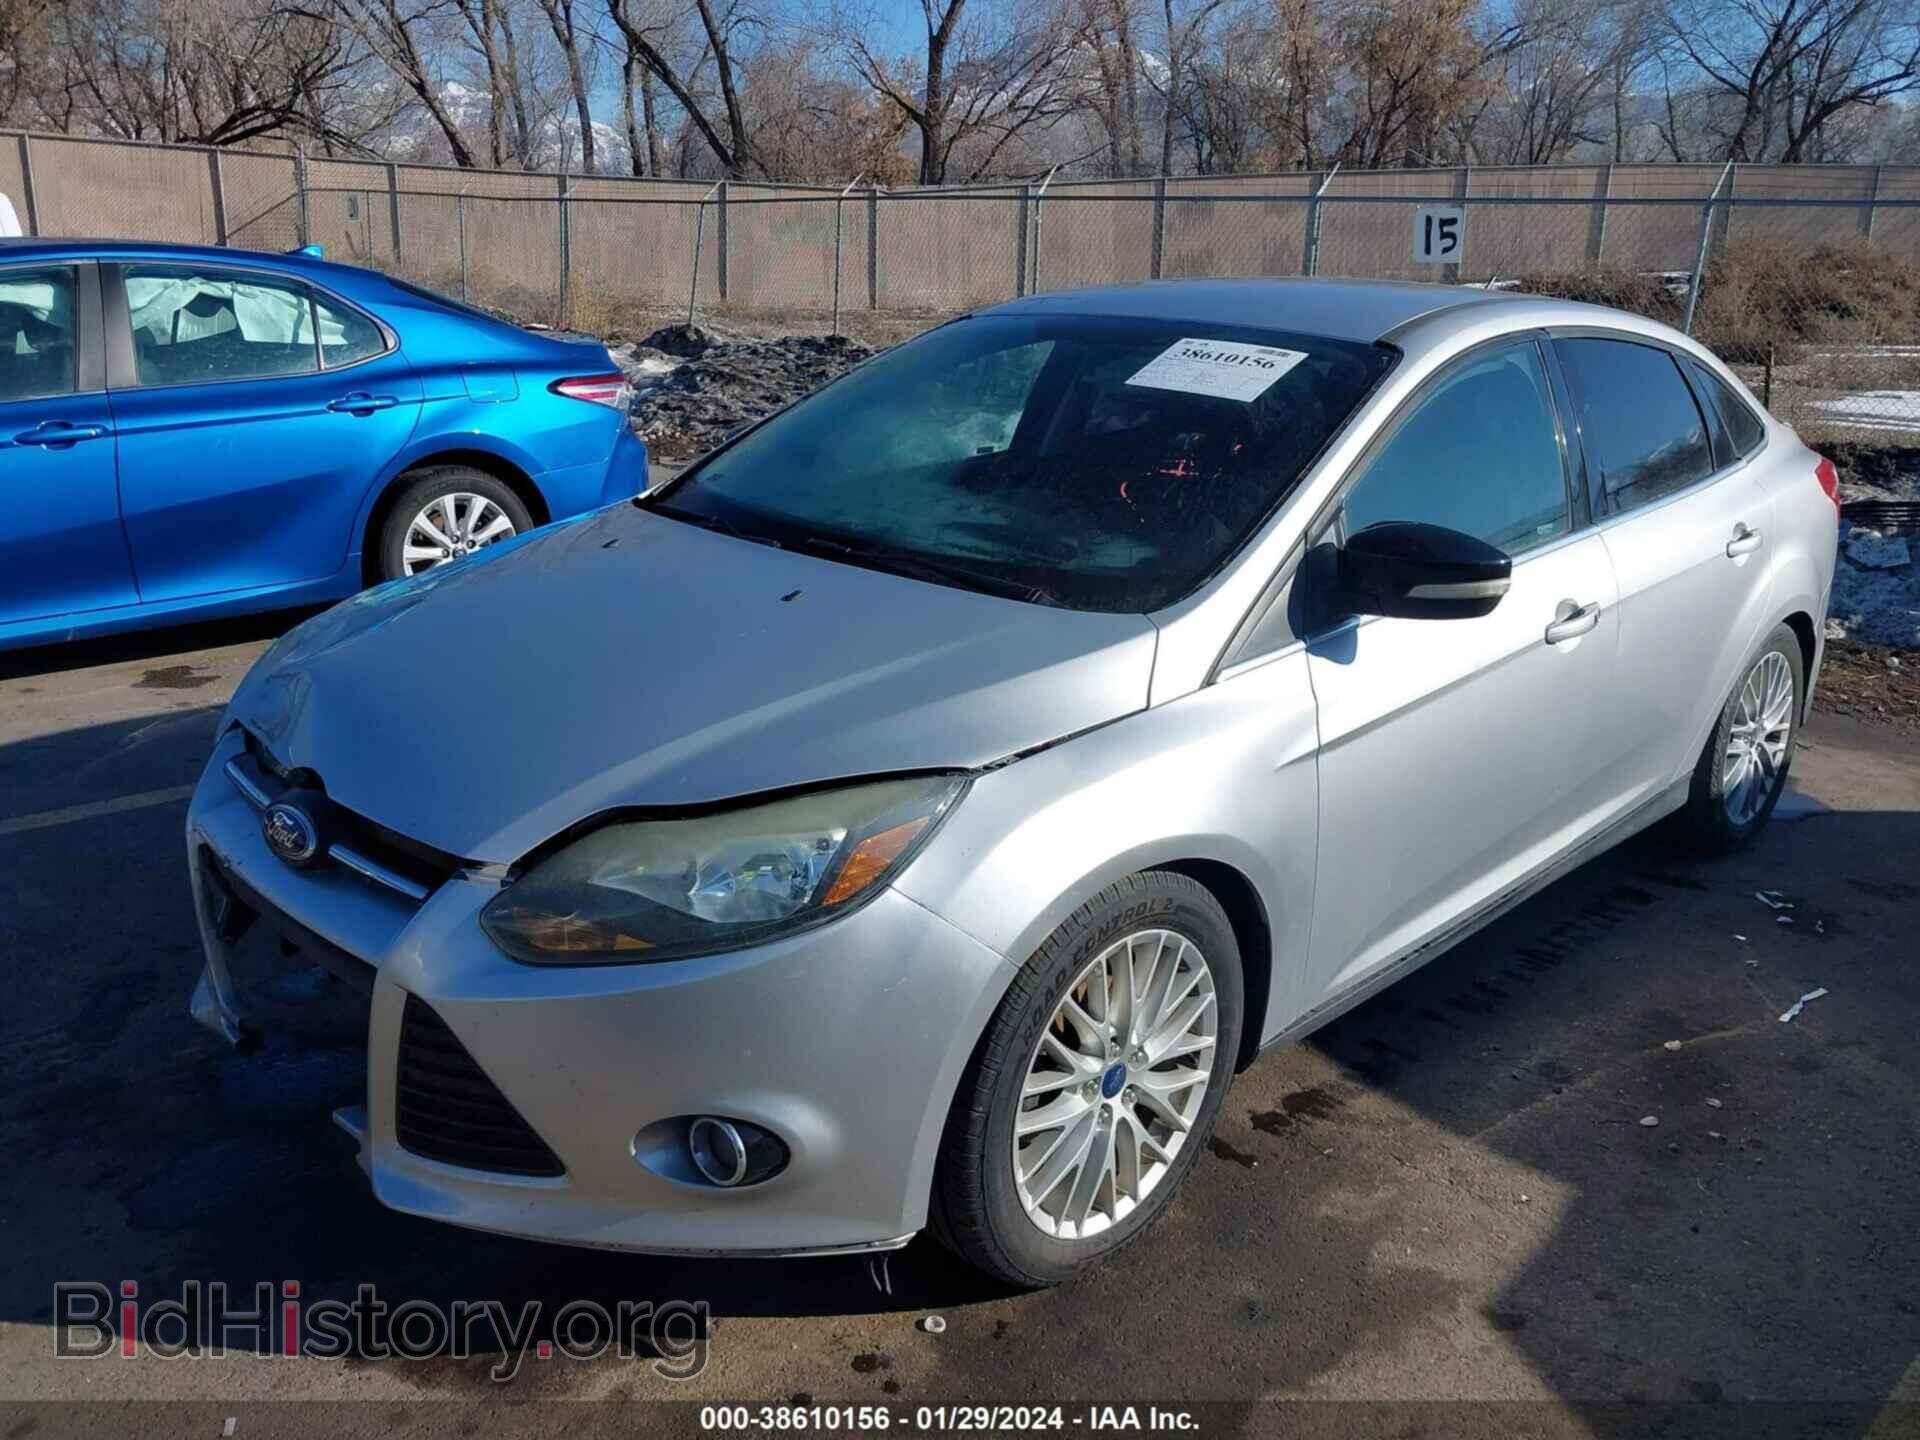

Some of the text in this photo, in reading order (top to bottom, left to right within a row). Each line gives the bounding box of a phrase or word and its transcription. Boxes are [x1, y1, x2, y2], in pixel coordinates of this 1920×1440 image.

[1424, 214, 1458, 255] 15
[1180, 348, 1276, 369] 38610156
[1072, 900, 1159, 967] CONTROL
